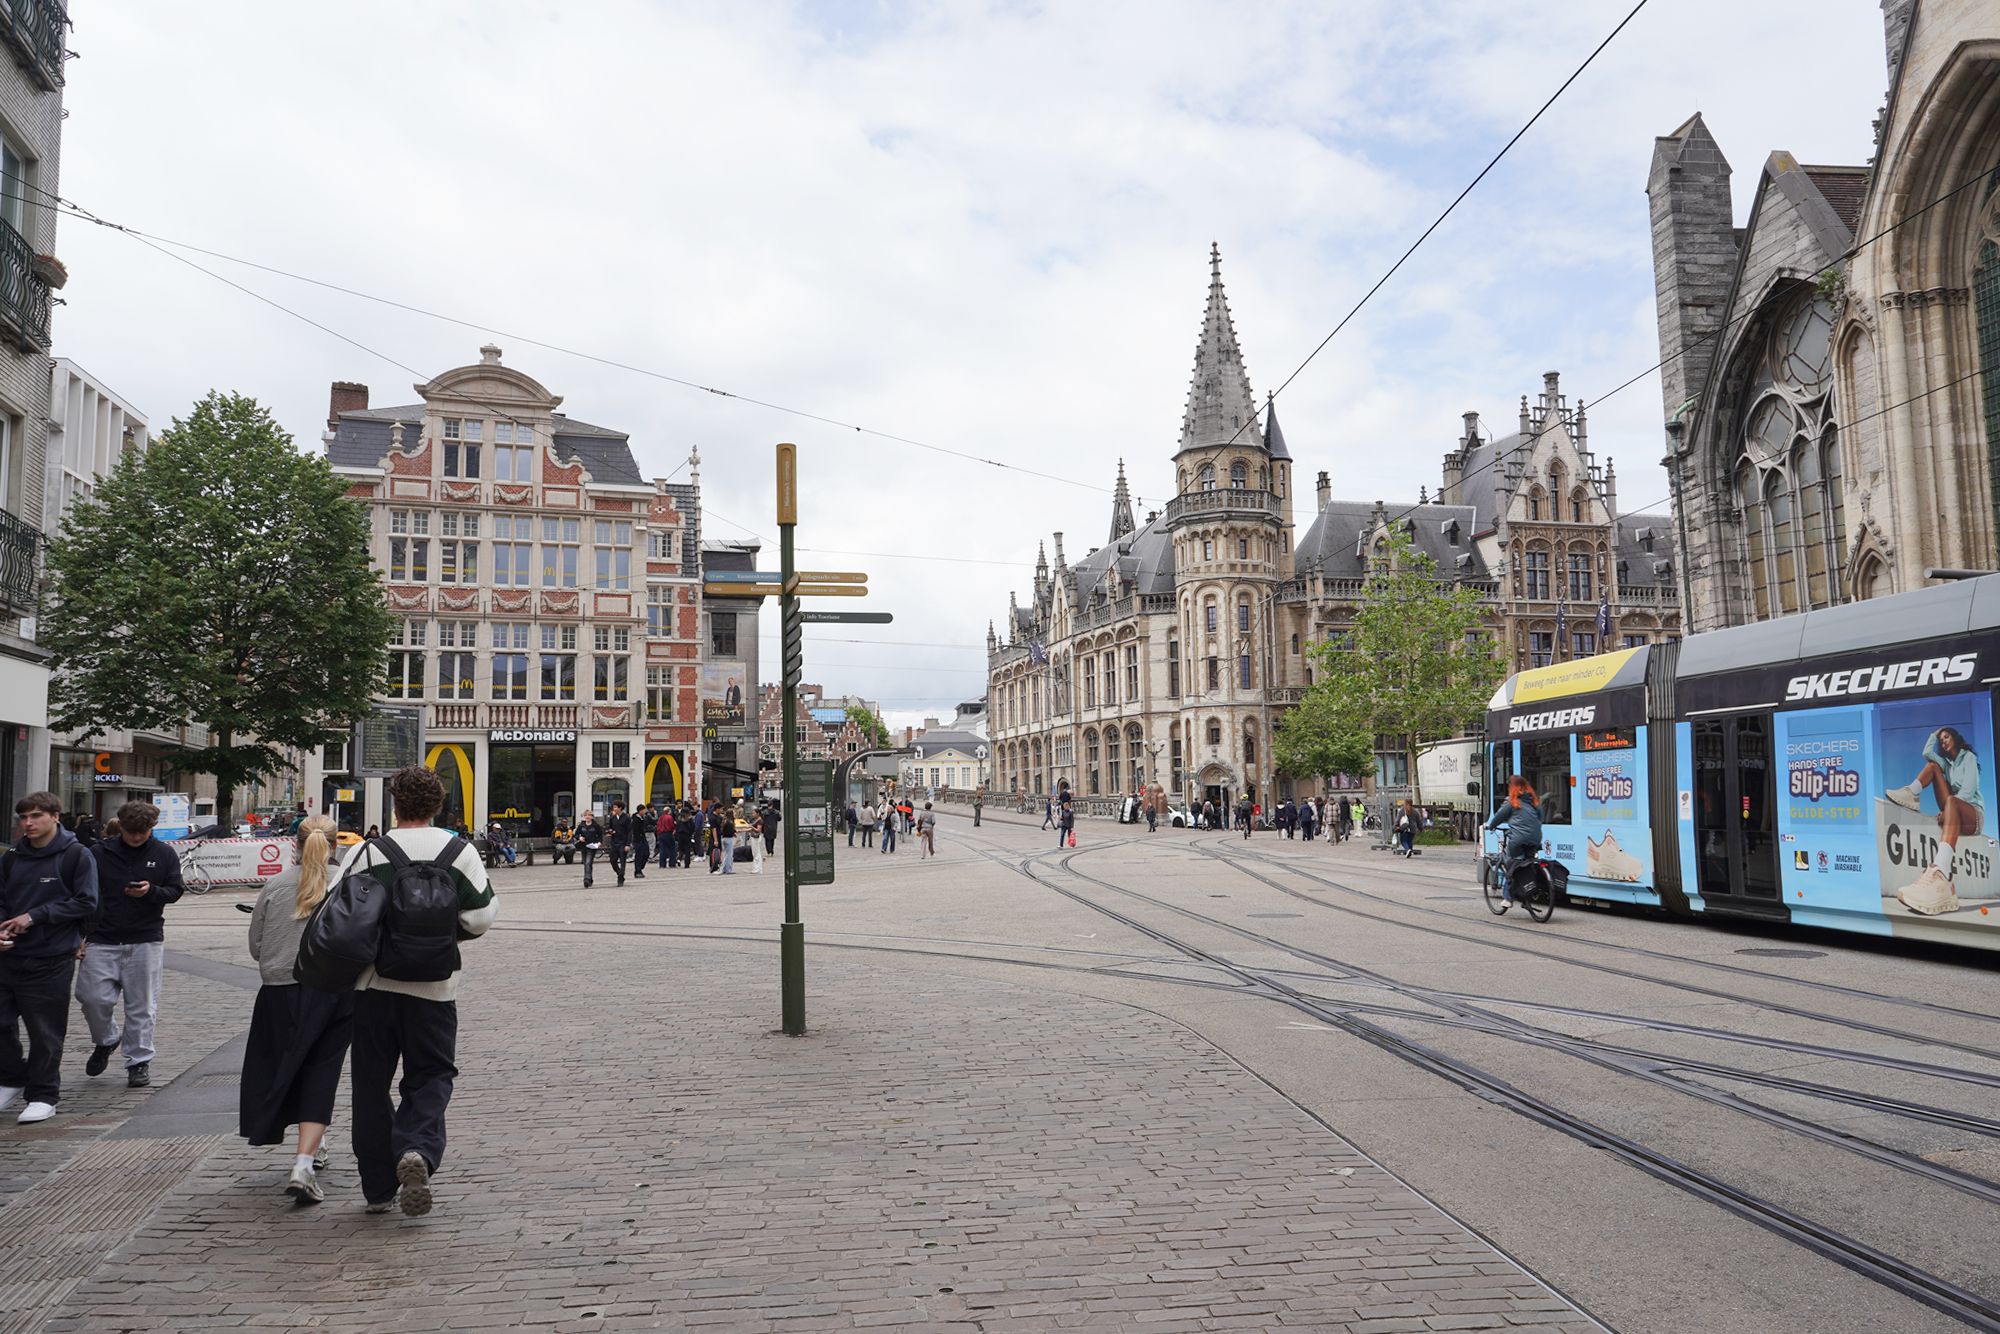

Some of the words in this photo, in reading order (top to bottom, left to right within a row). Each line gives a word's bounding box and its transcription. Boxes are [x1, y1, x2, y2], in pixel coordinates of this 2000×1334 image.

[1523, 679, 1544, 690] Beweeg
[1545, 677, 1557, 685] mee
[1558, 674, 1571, 683] naar
[1572, 669, 1594, 681] minder
[1785, 652, 1978, 702] SKECHERS
[706, 708, 741, 718] CHRISTY
[1509, 705, 1596, 734] SKECHERS
[491, 730, 575, 741] McDonald's
[1786, 740, 1859, 755] SKECHERS
[1584, 752, 1633, 764] SKECHERS
[1788, 759, 1818, 770] HANDS
[1819, 757, 1843, 768] FREE
[1585, 767, 1605, 776] HANDS
[1607, 765, 1622, 774] FREE
[1587, 777, 1632, 801] Slip-ins
[1791, 769, 1858, 799] Slip-ins
[1790, 807, 1861, 819] GLIDE-STEP
[1835, 854, 1860, 863] MACHINE
[1834, 863, 1862, 872] WASHABLE
